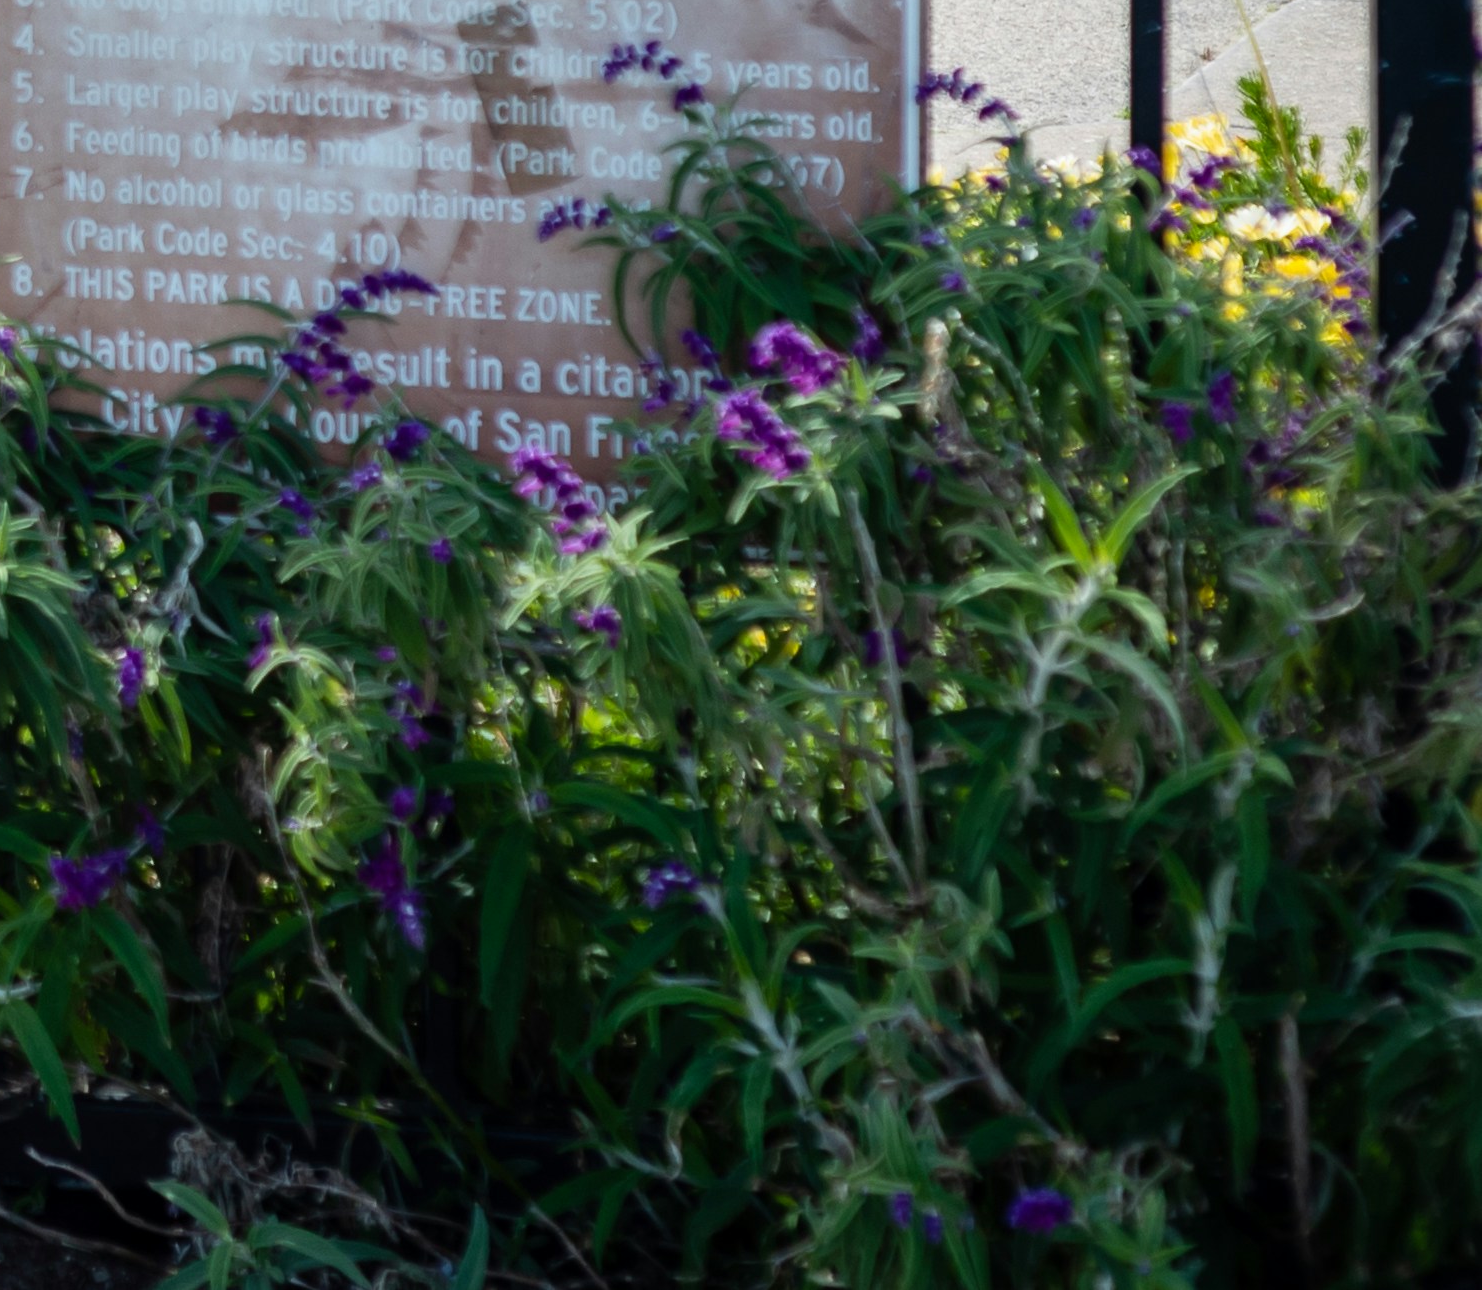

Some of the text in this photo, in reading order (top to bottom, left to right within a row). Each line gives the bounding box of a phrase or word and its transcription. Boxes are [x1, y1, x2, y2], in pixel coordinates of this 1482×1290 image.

[12, 22, 45, 57] 4.
[66, 25, 181, 61] Smaller
[190, 31, 256, 72] play
[267, 36, 416, 72] structure
[420, 39, 446, 72] is
[456, 43, 501, 75] for
[723, 60, 814, 95] years
[823, 61, 881, 94] old.
[15, 70, 45, 105] 5.
[66, 73, 164, 117] Larger
[174, 79, 239, 121] play
[250, 81, 392, 120] structure
[404, 89, 430, 121] is
[440, 91, 483, 122] for
[492, 93, 627, 137] children,
[729, 108, 817, 142] years
[826, 110, 884, 143] old.
[14, 121, 45, 154] 6.
[66, 121, 182, 169] Feeding
[193, 127, 225, 161] of
[230, 129, 308, 166] birds
[318, 134, 484, 174] prohibited.
[495, 140, 578, 181] (Park
[589, 145, 663, 182] Code
[15, 167, 45, 201] 7.
[66, 169, 105, 203] No
[115, 174, 223, 210] alcohol
[233, 184, 264, 212] or
[274, 181, 355, 222] glass
[365, 188, 527, 226] containers
[65, 218, 403, 270] (Park Code Sec. 4.10)
[12, 264, 45, 298] 8.
[63, 265, 136, 301] THIS
[146, 269, 229, 306] PARK
[239, 272, 273, 305] IS
[283, 276, 306, 311] A
[516, 288, 613, 327] ZONE.
[468, 347, 504, 392] in
[519, 359, 542, 395] a
[102, 386, 186, 440] City
[494, 409, 572, 458] San
